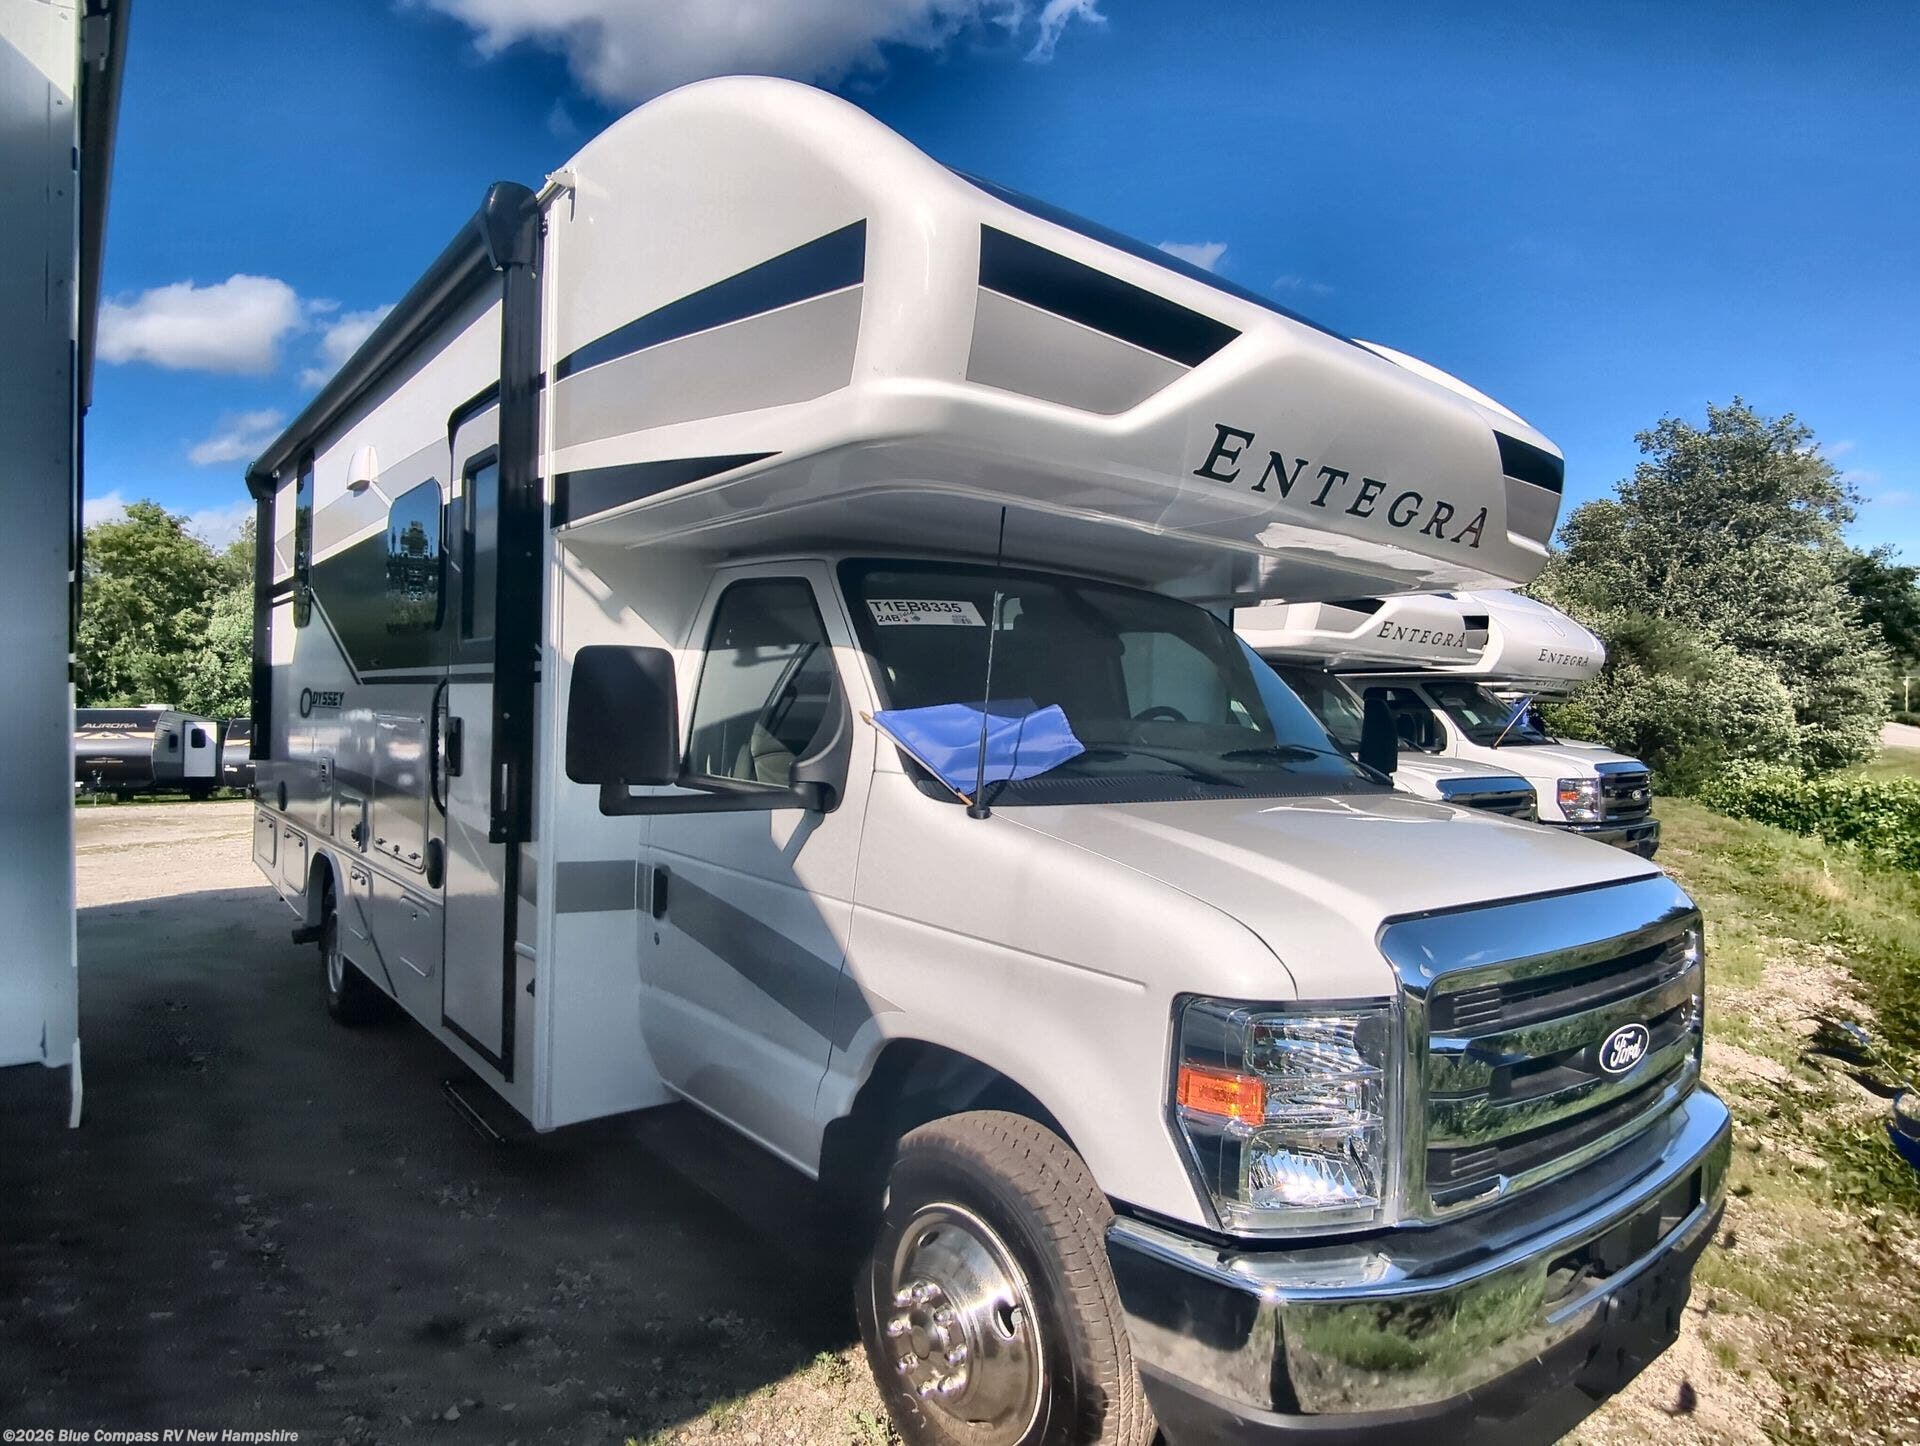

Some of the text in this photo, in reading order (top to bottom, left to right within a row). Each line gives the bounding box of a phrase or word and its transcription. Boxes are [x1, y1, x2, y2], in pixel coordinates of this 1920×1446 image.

[1193, 423, 1488, 549] ENTEGRA
[869, 601, 963, 613] T1EB8335
[877, 614, 901, 623] 24B
[1377, 620, 1466, 649] ENTEGRA
[1537, 648, 1590, 668] ENTEGRA
[299, 687, 345, 719] ODYSSEY
[1608, 1029, 1643, 1069] Ford
